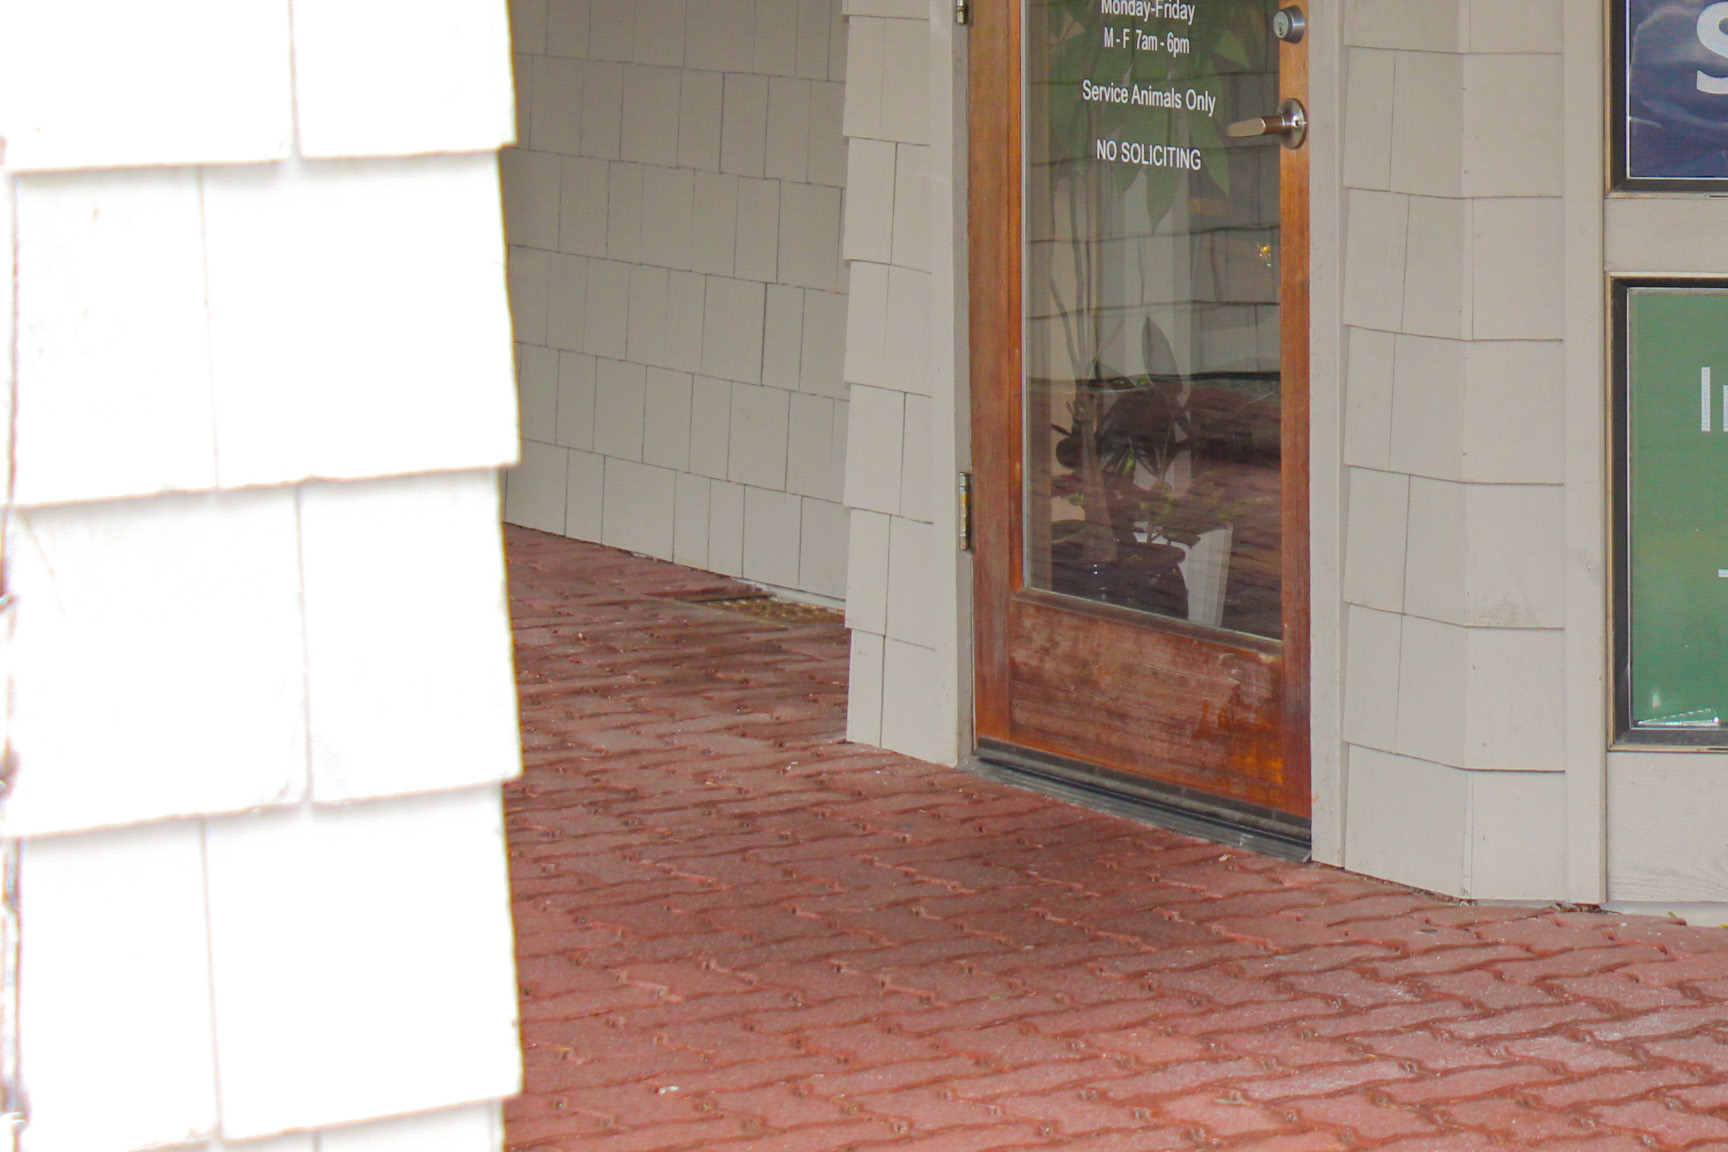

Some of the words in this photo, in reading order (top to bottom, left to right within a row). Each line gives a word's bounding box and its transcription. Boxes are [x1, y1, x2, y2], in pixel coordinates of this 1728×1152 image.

[1104, 27, 1114, 48] M
[1123, 28, 1130, 48] F
[1135, 29, 1158, 52] 7am
[1167, 31, 1190, 57] 6pm
[1082, 79, 1129, 103] Service
[1131, 84, 1182, 109] Animals
[1186, 88, 1216, 117] Only
[1096, 139, 1117, 161] NO
[1121, 141, 1201, 171] SOLICITING
